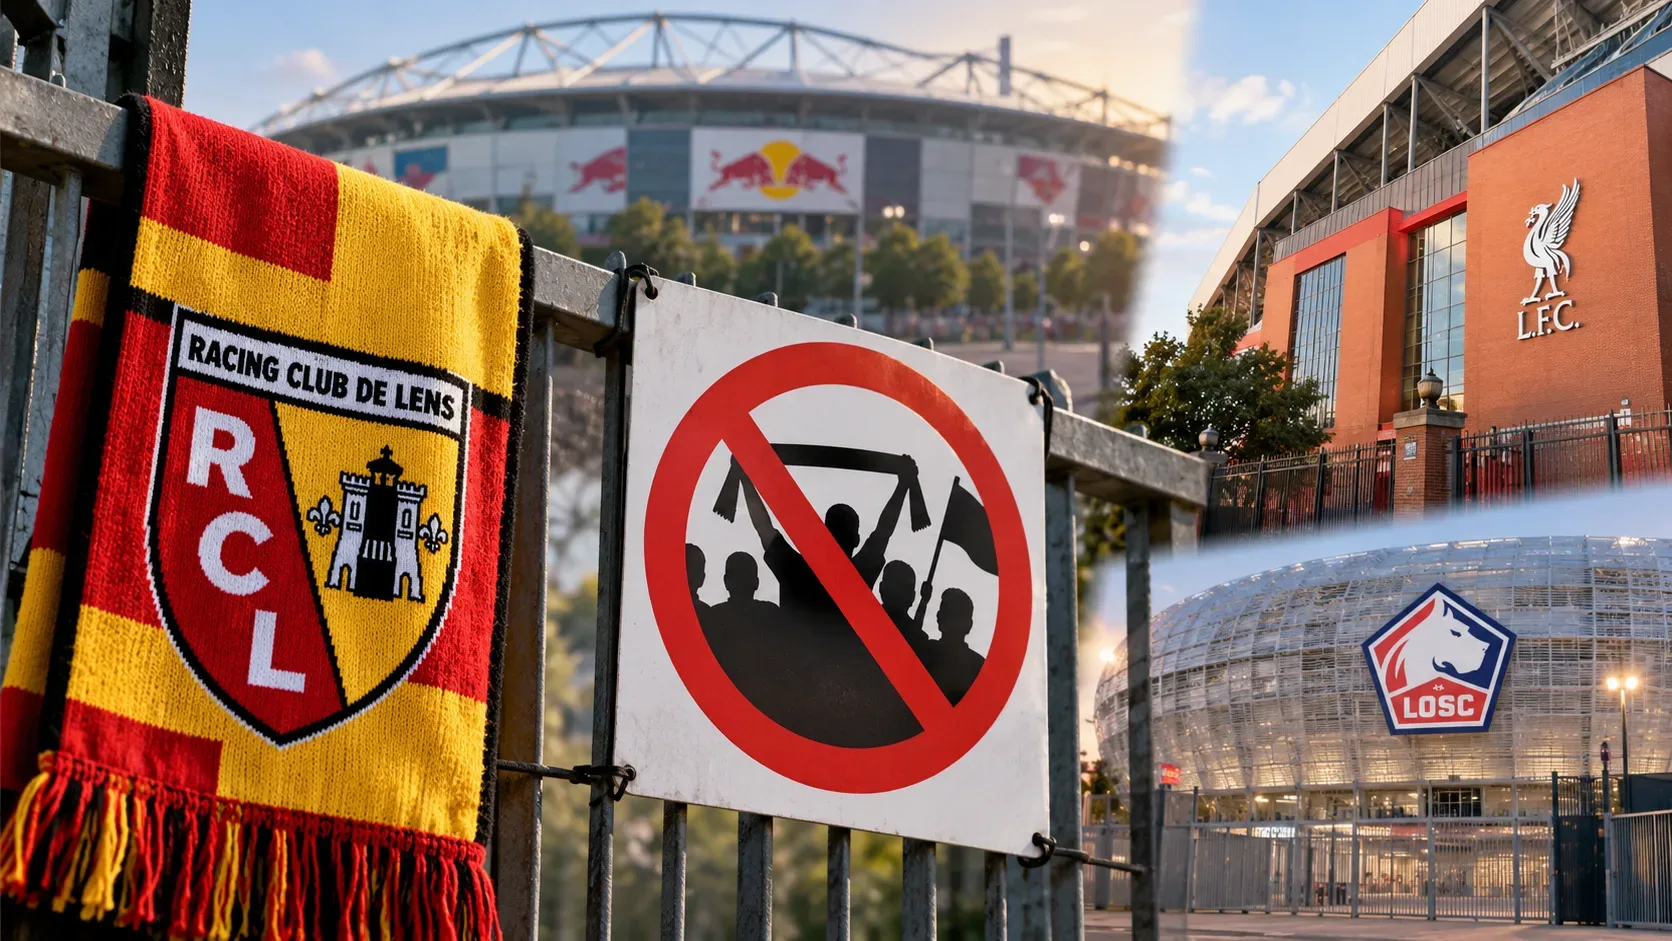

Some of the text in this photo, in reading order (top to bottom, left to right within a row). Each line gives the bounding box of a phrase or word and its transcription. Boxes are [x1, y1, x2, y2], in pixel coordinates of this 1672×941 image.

[1517, 299, 1580, 340] L.F.C.
[188, 333, 455, 421] RACING CLUB DE LENS
[1403, 694, 1475, 719] LOSC
